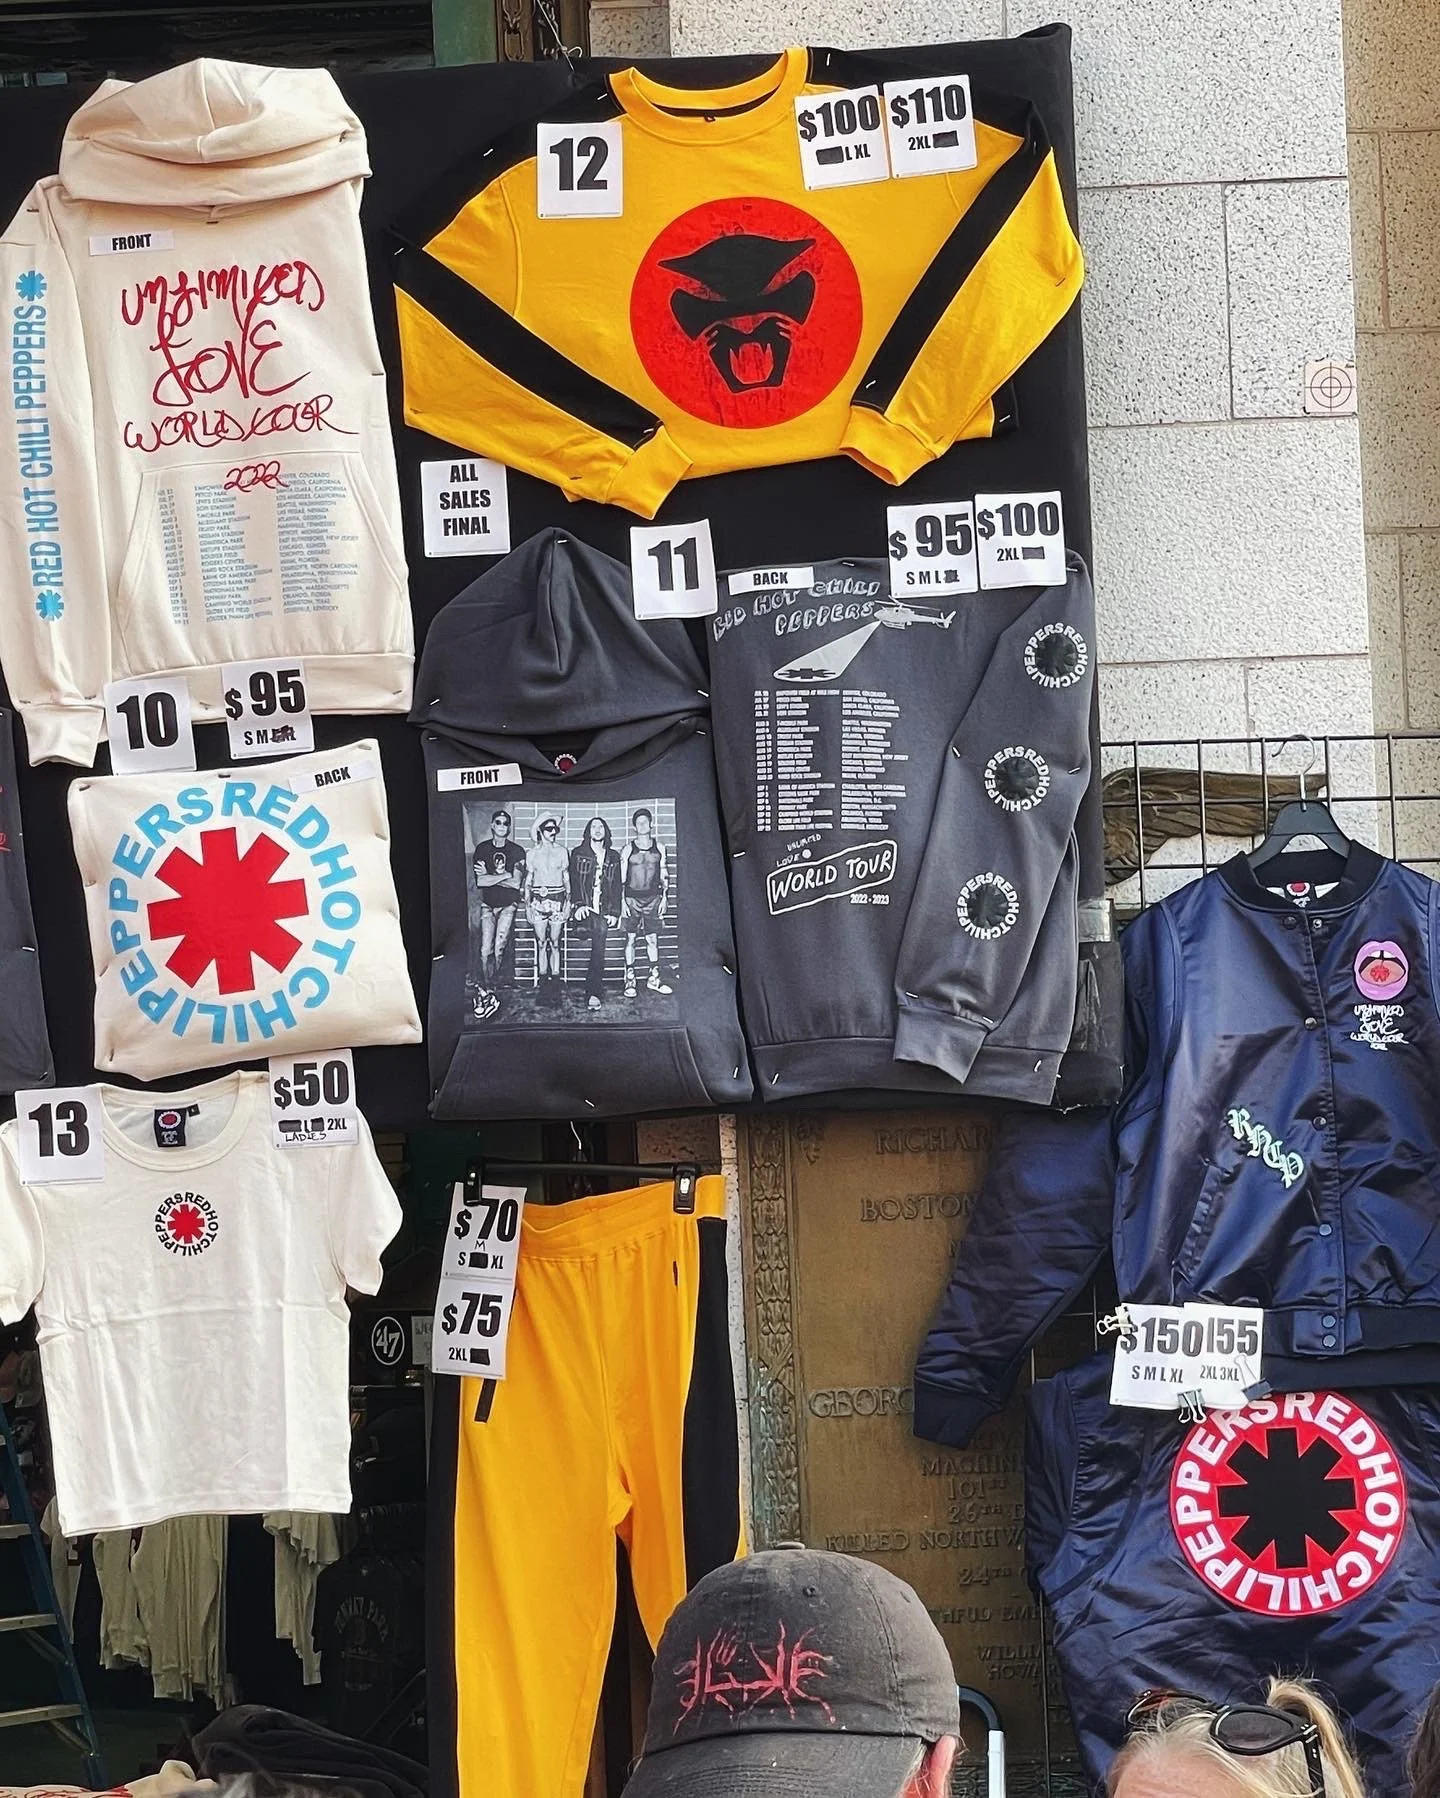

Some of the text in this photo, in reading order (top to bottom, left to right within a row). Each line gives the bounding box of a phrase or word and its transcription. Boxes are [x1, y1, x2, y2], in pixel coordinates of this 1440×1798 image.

[799, 84, 966, 141] $100 $110
[844, 143, 871, 161] L XL
[908, 135, 931, 151] 2XL
[549, 137, 608, 191] 12
[112, 234, 152, 251] FRONT
[13, 305, 64, 587] RED HOT CHILI PEPPERS
[224, 461, 289, 492] 2022
[449, 464, 478, 483] ALL
[439, 490, 491, 510] SALES
[443, 516, 490, 536] FINAL
[978, 502, 1059, 540] $100
[889, 513, 972, 560] $95
[647, 537, 700, 592] 11
[997, 548, 1019, 562] 2XL
[752, 571, 789, 585] BACK
[906, 570, 942, 585] S M L
[225, 669, 306, 721] $95
[116, 692, 178, 750] 10
[244, 730, 269, 745] S M
[315, 766, 351, 787] BACK
[460, 769, 500, 785] FRONT
[772, 850, 892, 903] WORLD TOUR
[274, 1060, 349, 1110] $50
[28, 1100, 90, 1157] 13
[327, 1118, 347, 1130] 2XL
[285, 1132, 326, 1142] LADIES
[875, 1125, 991, 1154] RICHAR
[454, 1198, 519, 1242] $70
[475, 1240, 486, 1252] M
[458, 1252, 504, 1269] S XL
[442, 1292, 503, 1337] $75
[448, 1348, 467, 1362] 2XL
[1132, 1365, 1239, 1383] S M L XL 2XL 3XL
